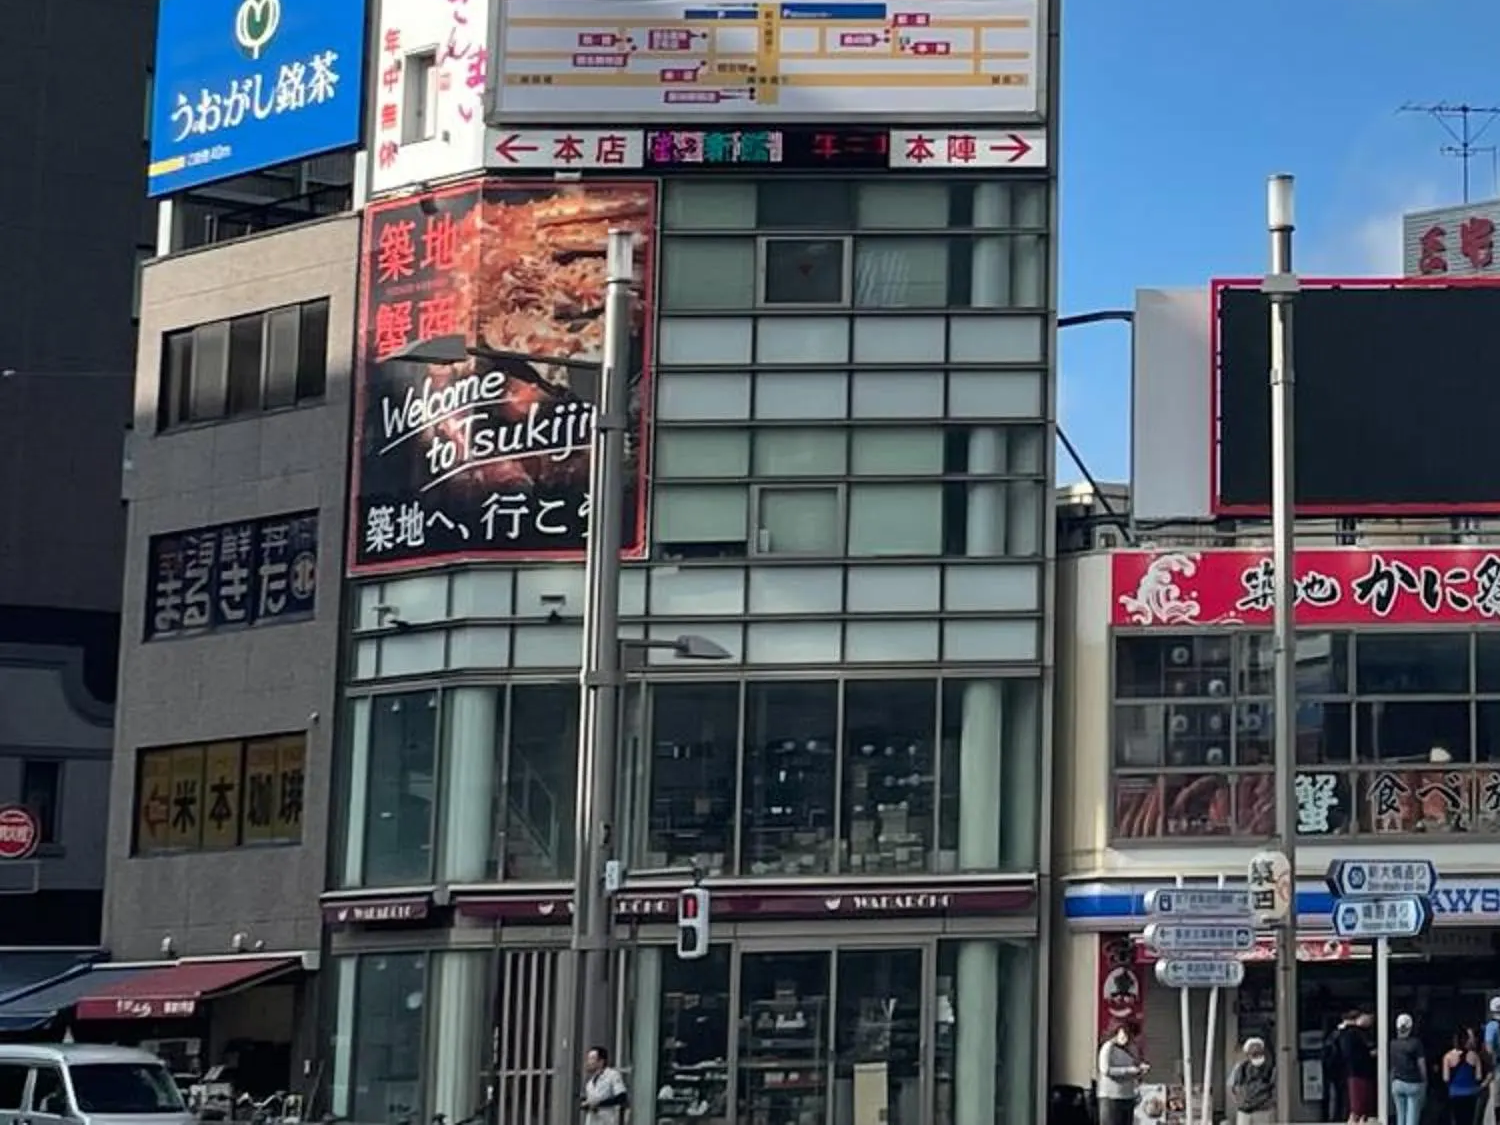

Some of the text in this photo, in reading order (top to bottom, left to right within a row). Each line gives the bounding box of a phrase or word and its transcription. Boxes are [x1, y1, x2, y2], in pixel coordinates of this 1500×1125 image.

[170, 49, 340, 143] うおがし銘茶
[553, 133, 628, 165] 本店
[904, 133, 977, 164] 本陣
[377, 211, 459, 283] 築地
[381, 370, 506, 438] Welcome
[426, 436, 458, 475] to
[172, 769, 305, 834] 米本珈琲
[1294, 773, 1339, 833] 蟹
